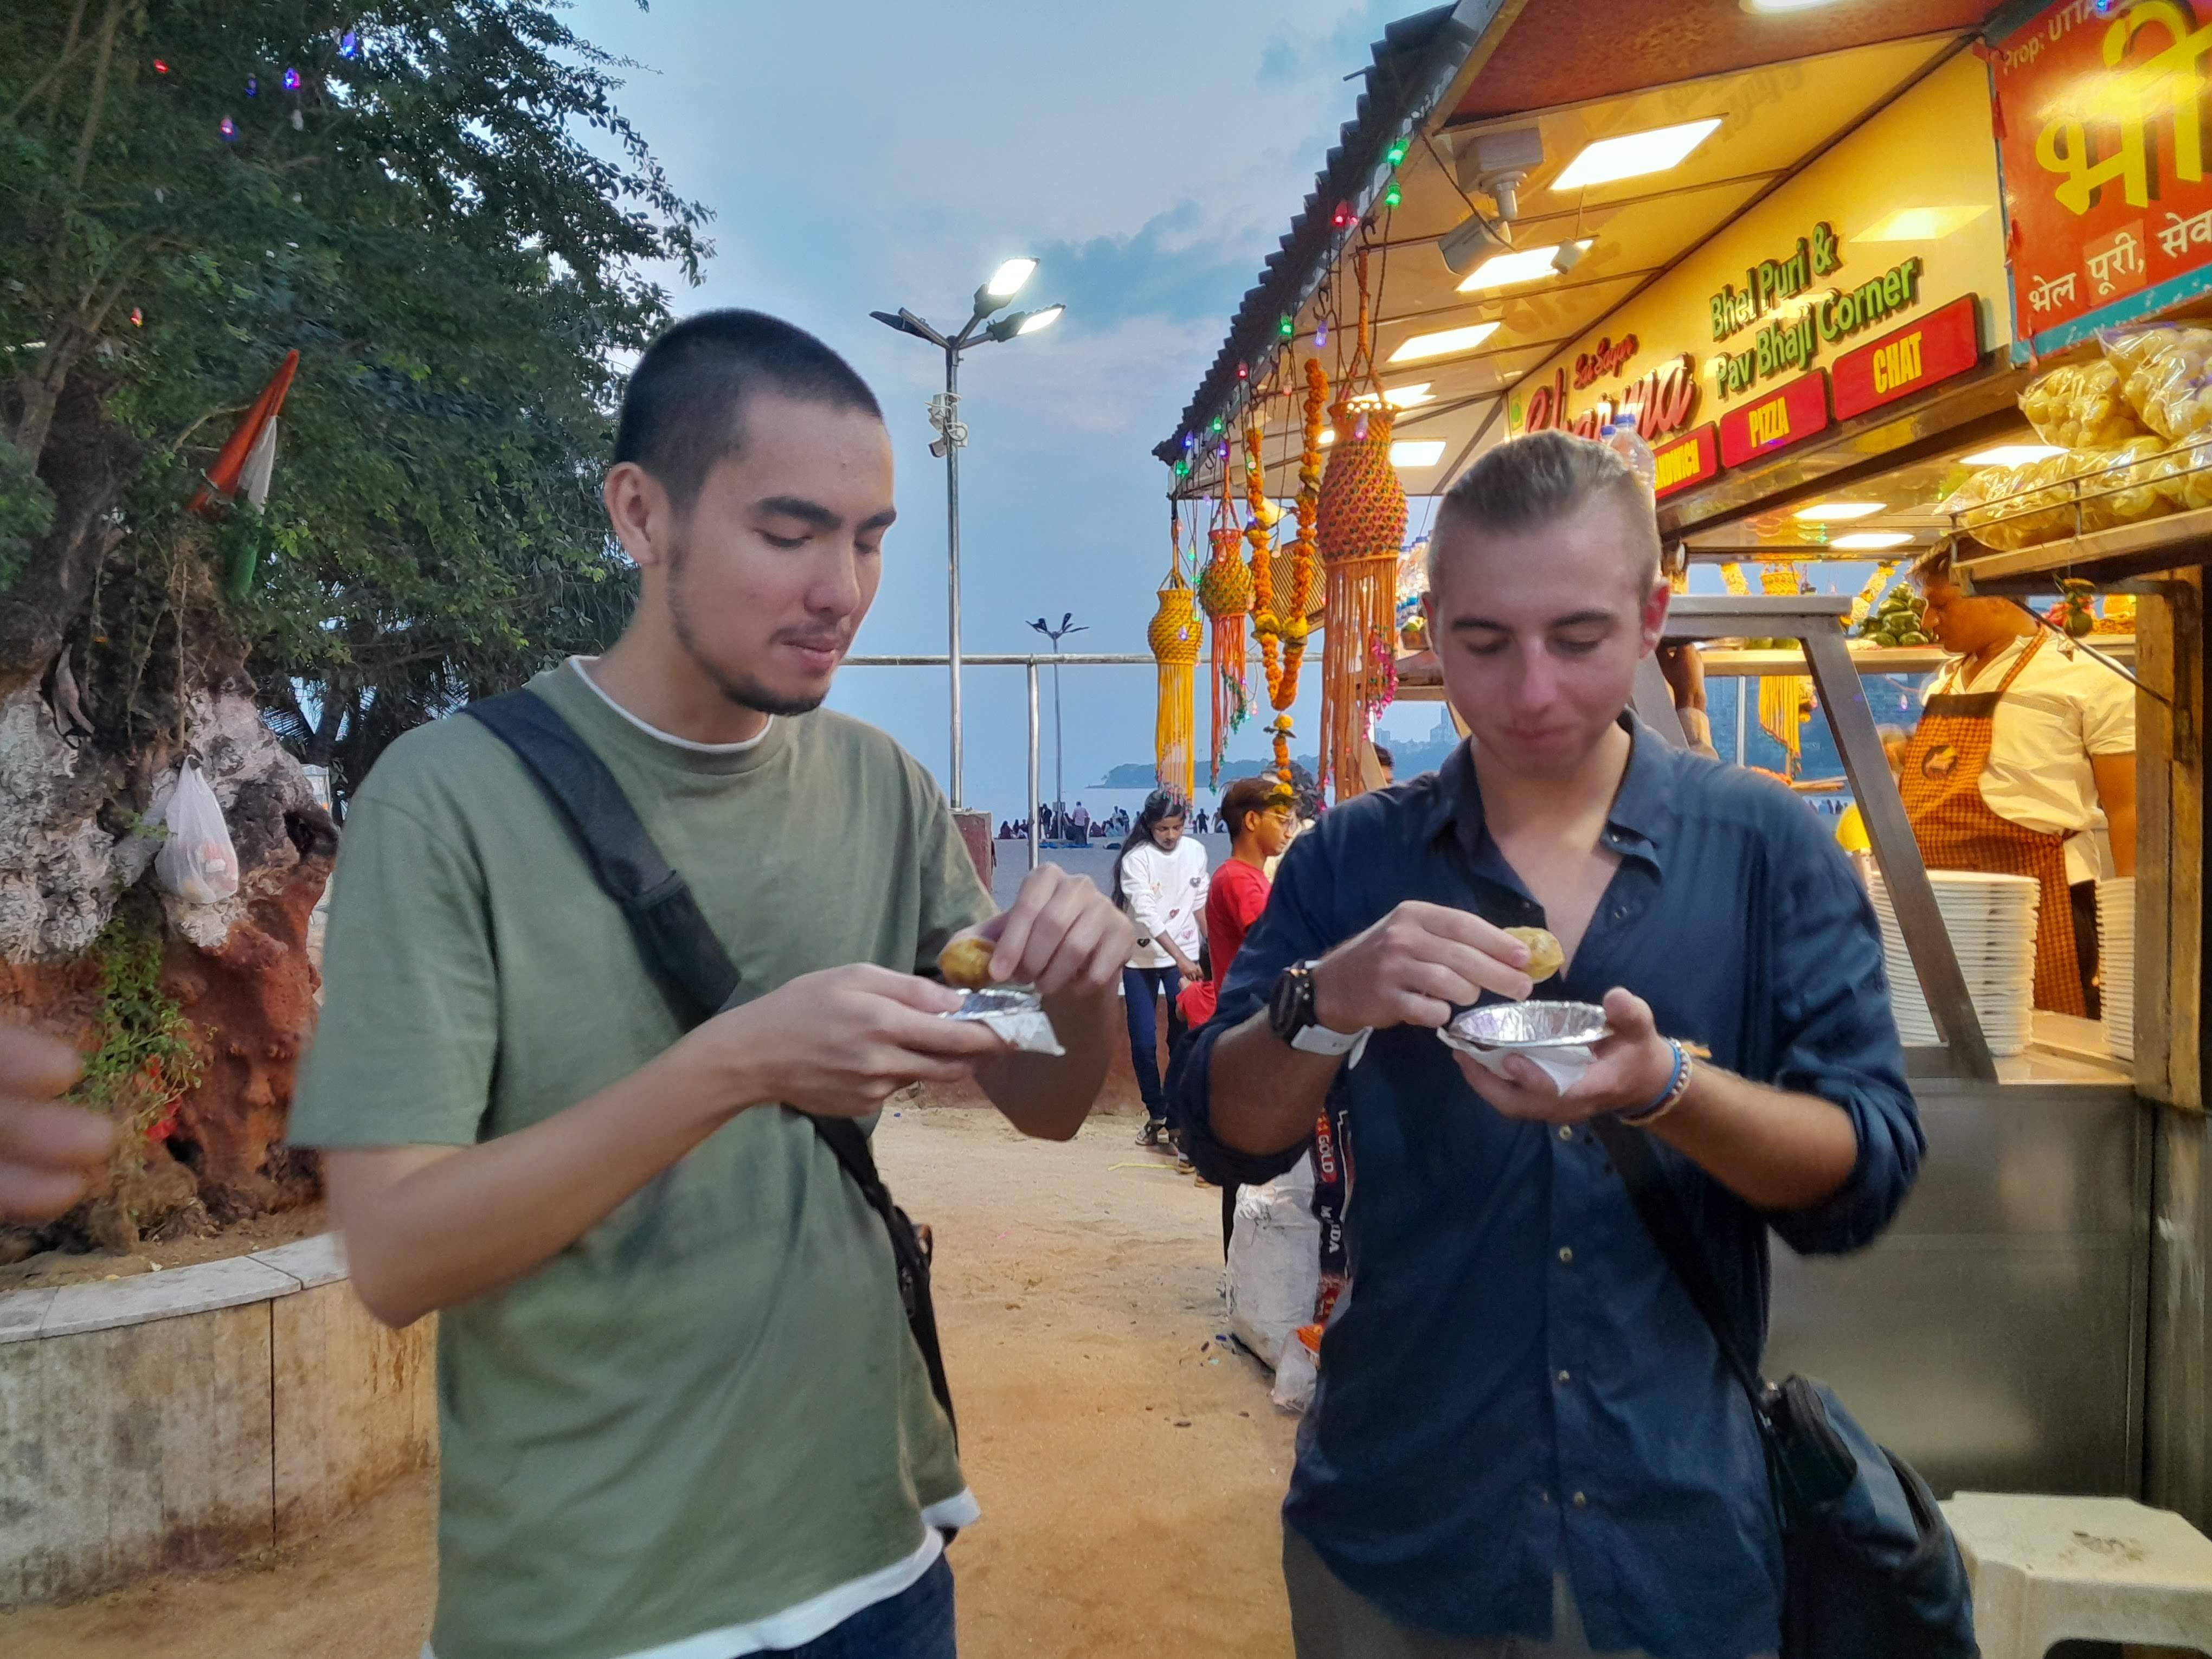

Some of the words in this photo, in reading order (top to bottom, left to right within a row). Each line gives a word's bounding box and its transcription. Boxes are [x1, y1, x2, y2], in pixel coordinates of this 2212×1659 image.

[1710, 267, 1758, 342] Bhel
[1758, 237, 1812, 299] Puri
[1812, 221, 1843, 276] &
[2028, 271, 2076, 312] भेल
[2086, 232, 2145, 295] पूरी,
[1714, 347, 1757, 400] Pav
[1756, 301, 1815, 378] Bhaji
[1818, 256, 1922, 343] Corner
[1873, 331, 1922, 395] CHAT
[1748, 396, 1790, 449] PIZZA
[1316, 1134, 1335, 1174] GOLD
